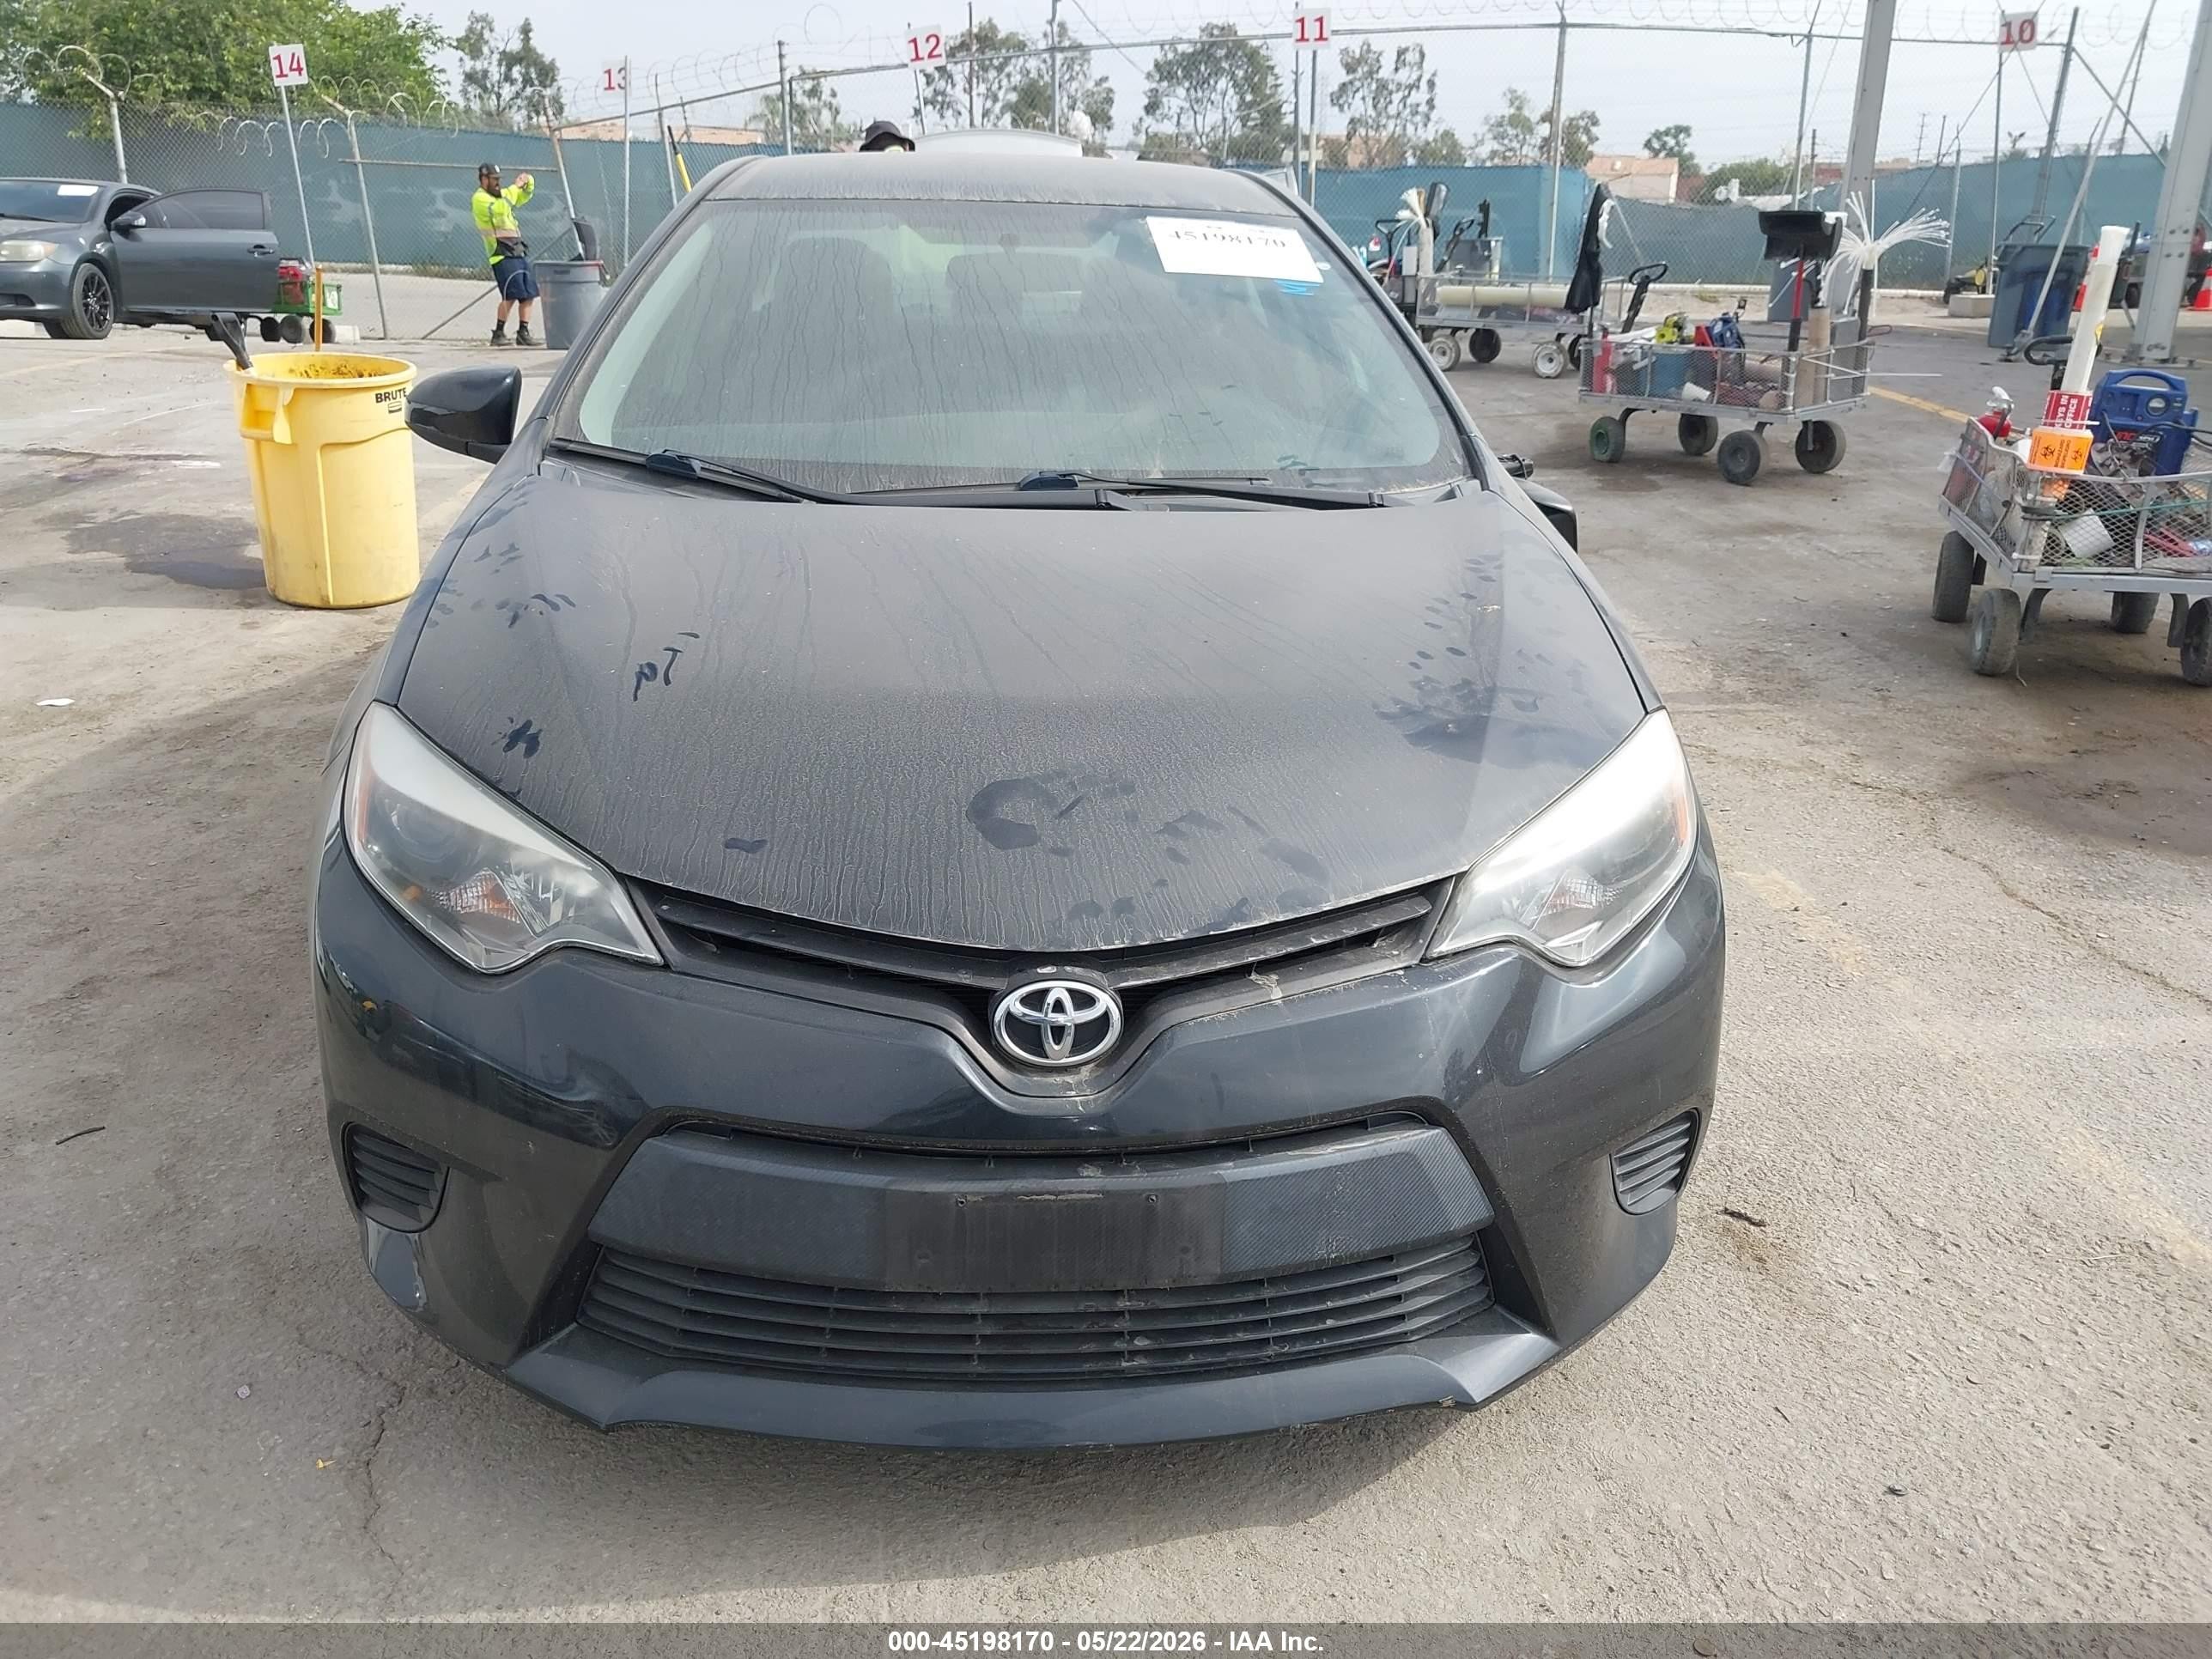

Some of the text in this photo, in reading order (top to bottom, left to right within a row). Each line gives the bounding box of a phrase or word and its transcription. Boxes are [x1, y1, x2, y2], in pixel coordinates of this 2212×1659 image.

[1295, 15, 1328, 43] 11
[2001, 19, 2035, 45] 10
[908, 33, 942, 62] 12
[272, 52, 304, 78] 14
[374, 386, 407, 404] BRUTE
[2064, 398, 2078, 428] OFFICE
